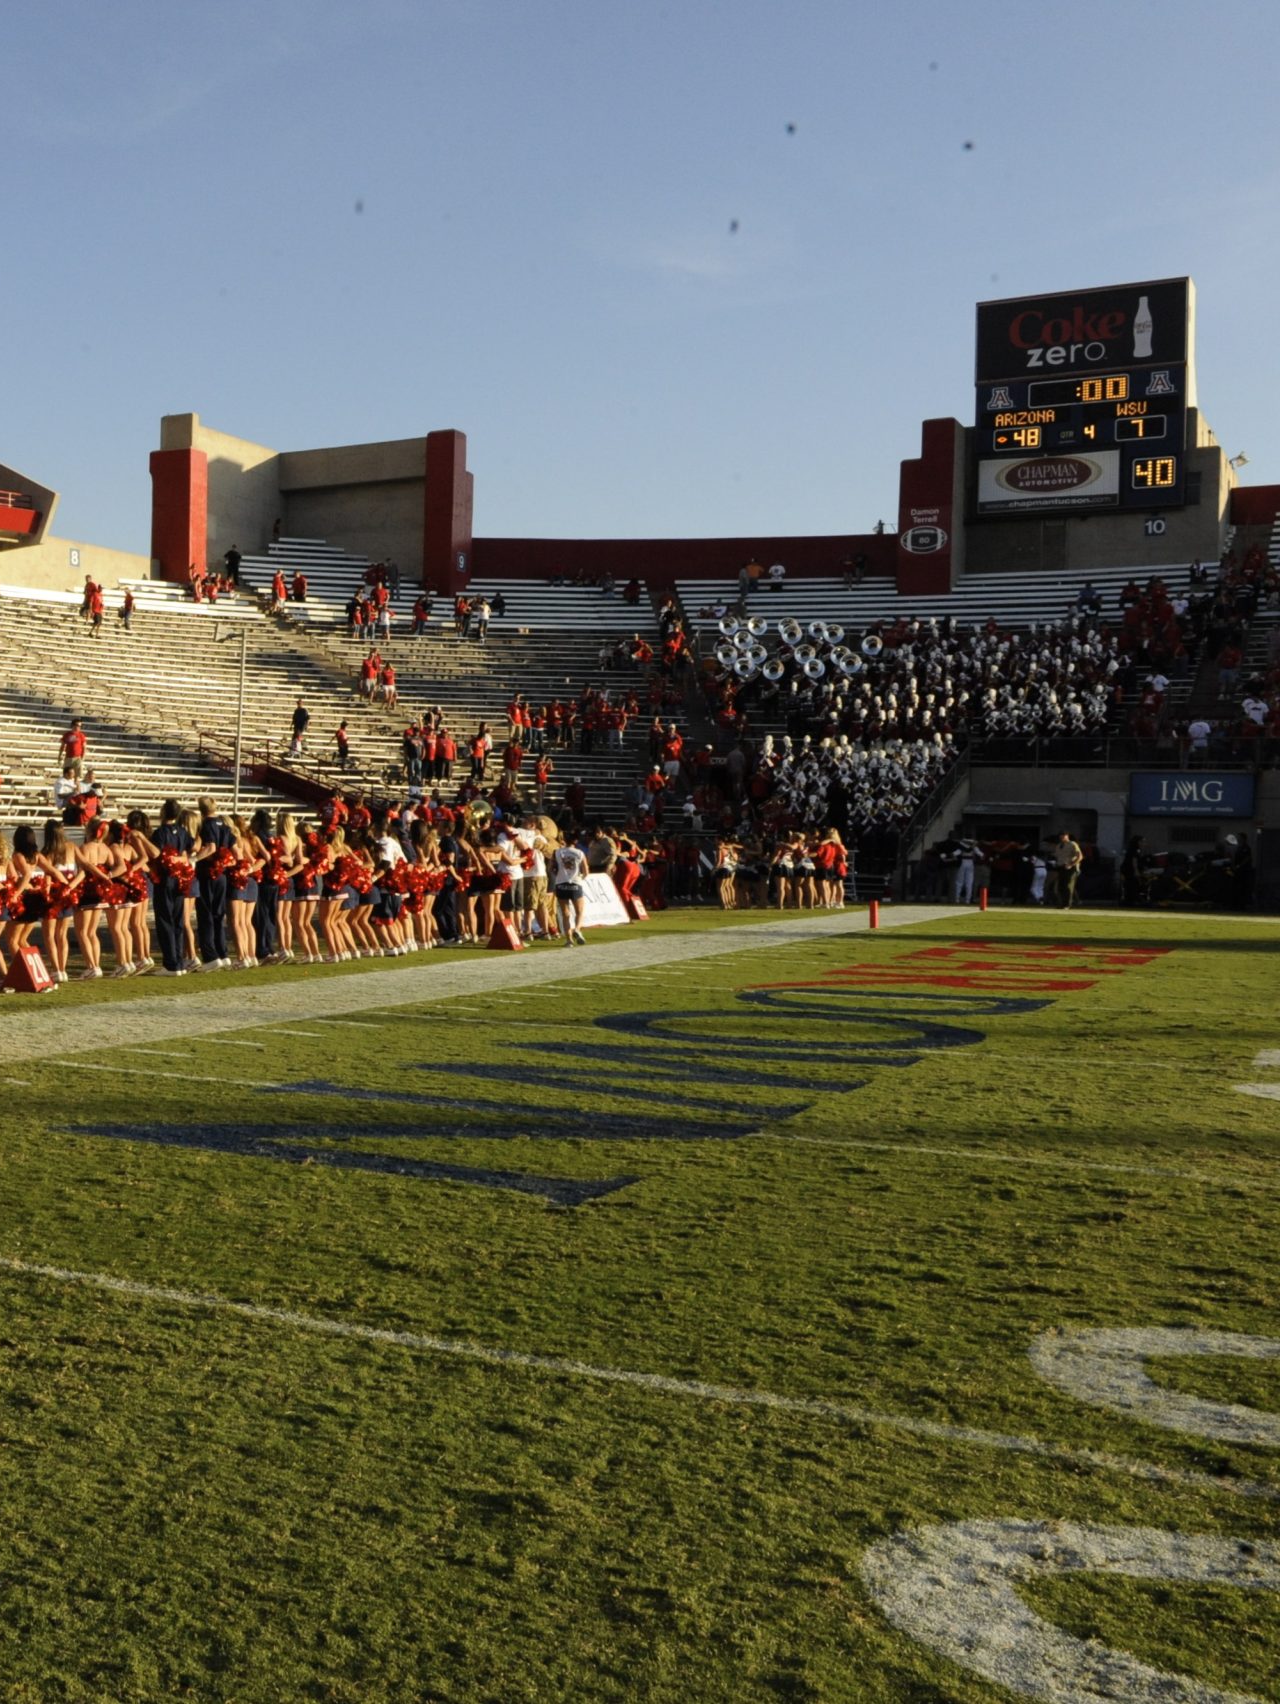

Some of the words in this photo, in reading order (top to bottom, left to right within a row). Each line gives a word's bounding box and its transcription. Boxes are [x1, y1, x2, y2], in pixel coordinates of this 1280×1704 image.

[1009, 304, 1126, 349] Coke
[1026, 342, 1106, 368] zero
[1116, 401, 1148, 416] WSU
[995, 410, 1056, 427] ARIZONA
[1083, 424, 1095, 440] 4
[1130, 419, 1144, 437] 7
[1013, 428, 1040, 447] 48
[1017, 463, 1079, 480] CHAPMAN
[1135, 459, 1173, 486] 40
[1019, 478, 1078, 487] AUTOMOTIVE
[1145, 519, 1166, 534] 10
[71, 550, 79, 565] 8
[458, 555, 465, 568] 9
[1160, 780, 1224, 802] IMG
[26, 952, 50, 983] 20
